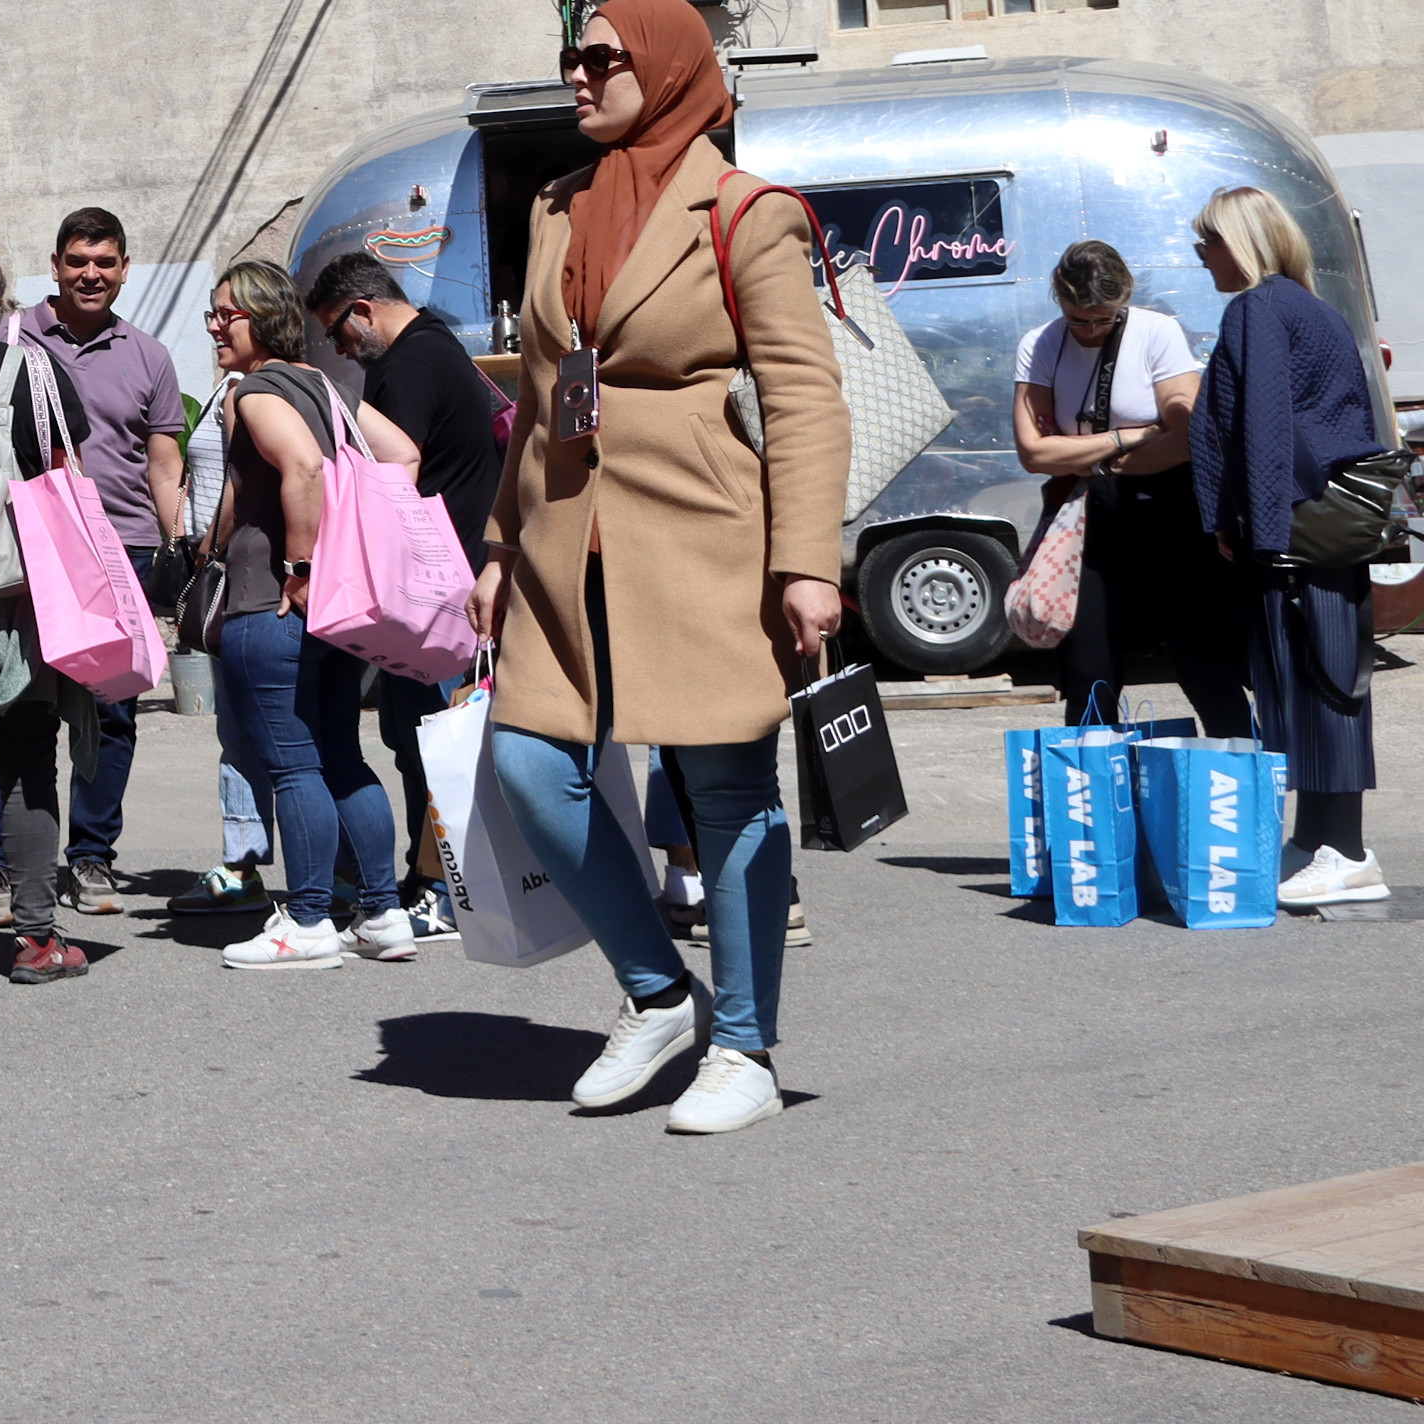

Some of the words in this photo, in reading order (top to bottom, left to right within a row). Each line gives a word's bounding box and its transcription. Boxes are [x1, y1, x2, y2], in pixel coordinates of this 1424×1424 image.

[870, 206, 1016, 296] Chrome
[1096, 361, 1114, 420] PONSA
[1066, 766, 1093, 827] AW
[1209, 769, 1238, 834] AW
[439, 840, 474, 912] Abacus
[1069, 840, 1098, 907] LAB
[1208, 845, 1238, 914] LAB
